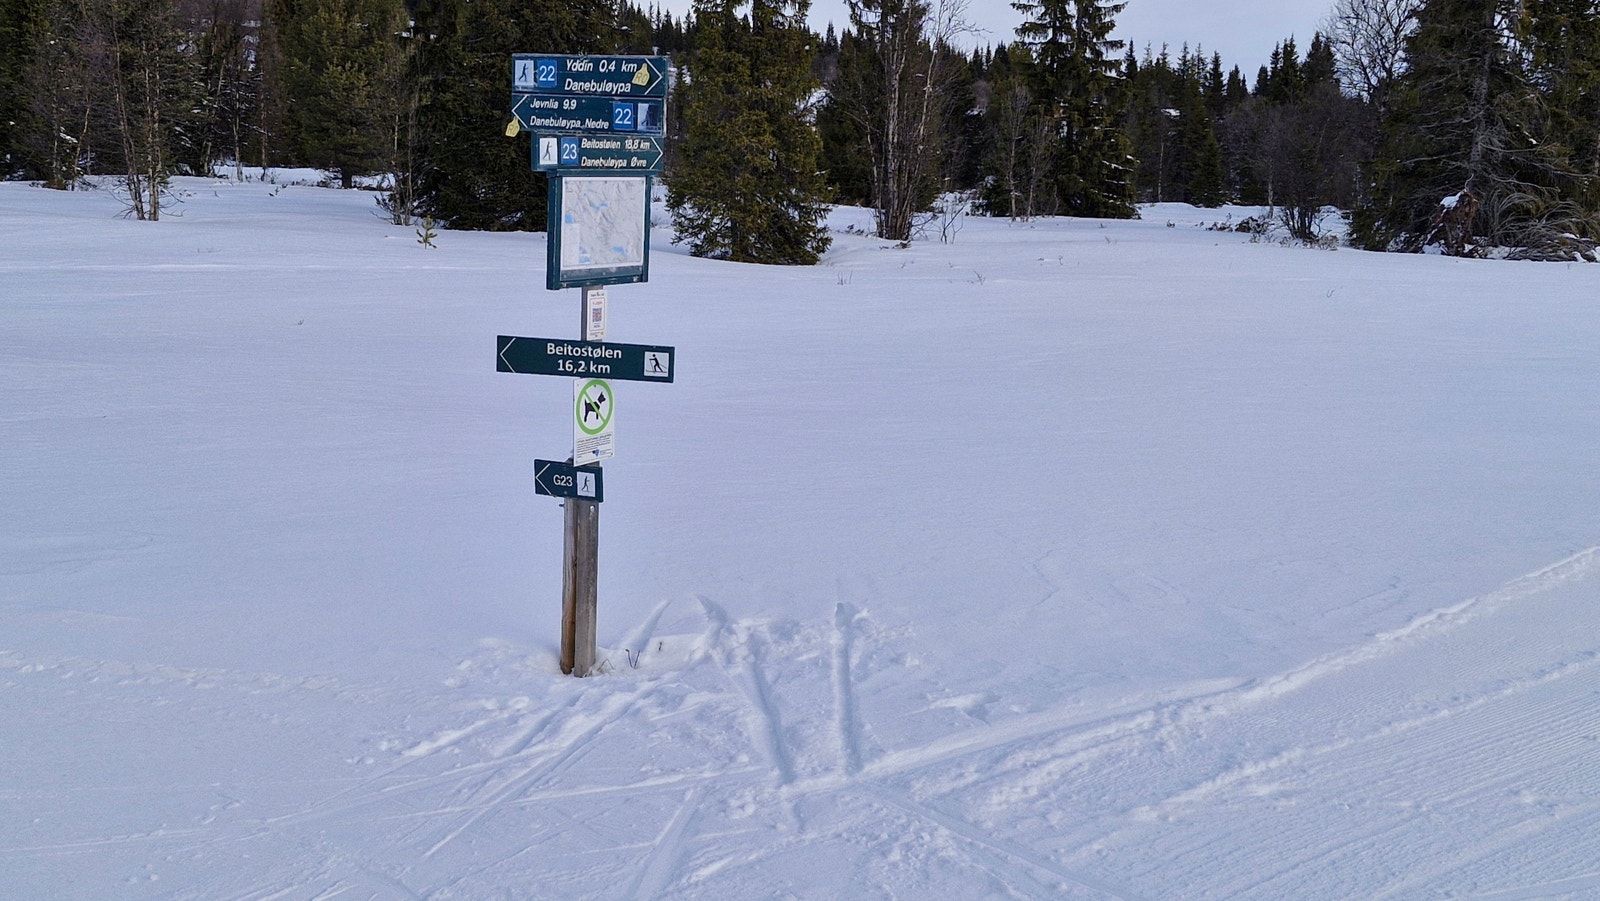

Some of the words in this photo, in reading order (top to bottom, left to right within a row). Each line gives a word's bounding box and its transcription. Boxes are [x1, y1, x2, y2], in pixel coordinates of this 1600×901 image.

[539, 66, 555, 81] 22
[566, 59, 593, 72] Yddin
[599, 60, 615, 73] 0,4
[621, 60, 637, 73] km
[564, 78, 631, 95] Danebuløypa
[530, 98, 558, 109] Jevnlia
[563, 99, 577, 110] 9,9
[530, 115, 581, 129] Danebuløypa
[585, 118, 609, 130] Nedre
[615, 108, 632, 125] 22
[562, 144, 577, 160] 23
[640, 140, 650, 150] km
[581, 156, 627, 170] Danebuløypa
[630, 157, 647, 168] Øvre
[547, 343, 622, 359] Beitostølen
[557, 360, 585, 375] 16,2
[590, 360, 610, 374] km
[553, 474, 573, 487] G23
